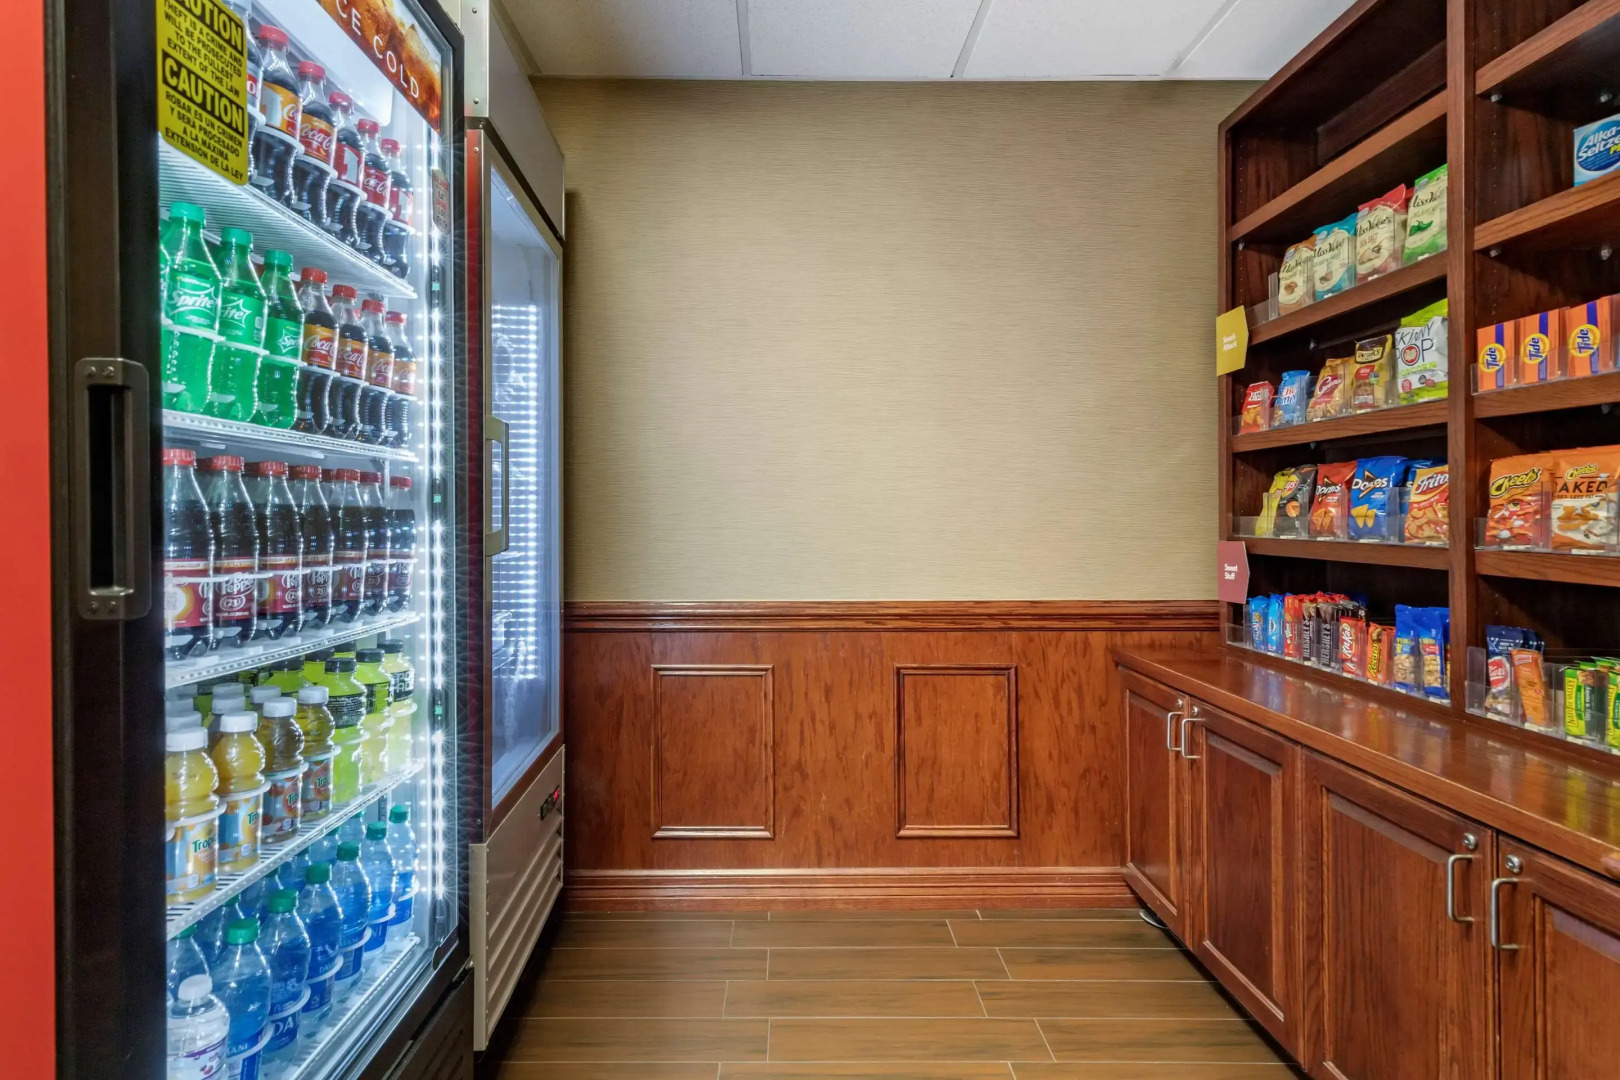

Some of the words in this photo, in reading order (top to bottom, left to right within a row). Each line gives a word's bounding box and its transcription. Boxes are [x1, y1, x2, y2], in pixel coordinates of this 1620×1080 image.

[164, 11, 183, 33] WILL
[185, 28, 195, 41] BE
[197, 37, 242, 78] PROSECUTED
[167, 37, 198, 66] EXTENT
[200, 62, 208, 74] OF
[210, 70, 225, 87] THE
[226, 82, 240, 99] LAW
[175, 30, 186, 45] TO
[188, 40, 202, 58] THE
[204, 54, 233, 82] FULLEST
[189, 19, 197, 31] IS
[199, 27, 204, 37] A
[206, 32, 227, 56] CRIME
[229, 52, 243, 67] AND
[336, 0, 362, 36] CE
[373, 35, 419, 99] COLD
[164, 57, 243, 134] CAUTION
[165, 90, 192, 114] ROBAR
[194, 109, 203, 123] ES
[205, 117, 215, 130] UN
[217, 125, 243, 149] CRIMEN
[165, 127, 208, 160] EXTENSION
[210, 154, 219, 168] DE
[221, 161, 230, 174] LA
[231, 167, 243, 181] LEY
[170, 105, 175, 116] Y
[177, 111, 197, 130] SERA
[199, 124, 240, 157] PROCESADO
[183, 126, 188, 136] A
[190, 130, 199, 142] LA
[202, 138, 229, 162] MAXIMA
[1578, 135, 1620, 162] Seltze
[1485, 347, 1501, 370] Tide
[1528, 336, 1544, 361] Tide
[1577, 328, 1596, 354] Tide
[1414, 471, 1449, 495] Frito
[1321, 623, 1331, 667] HERSHEY'S
